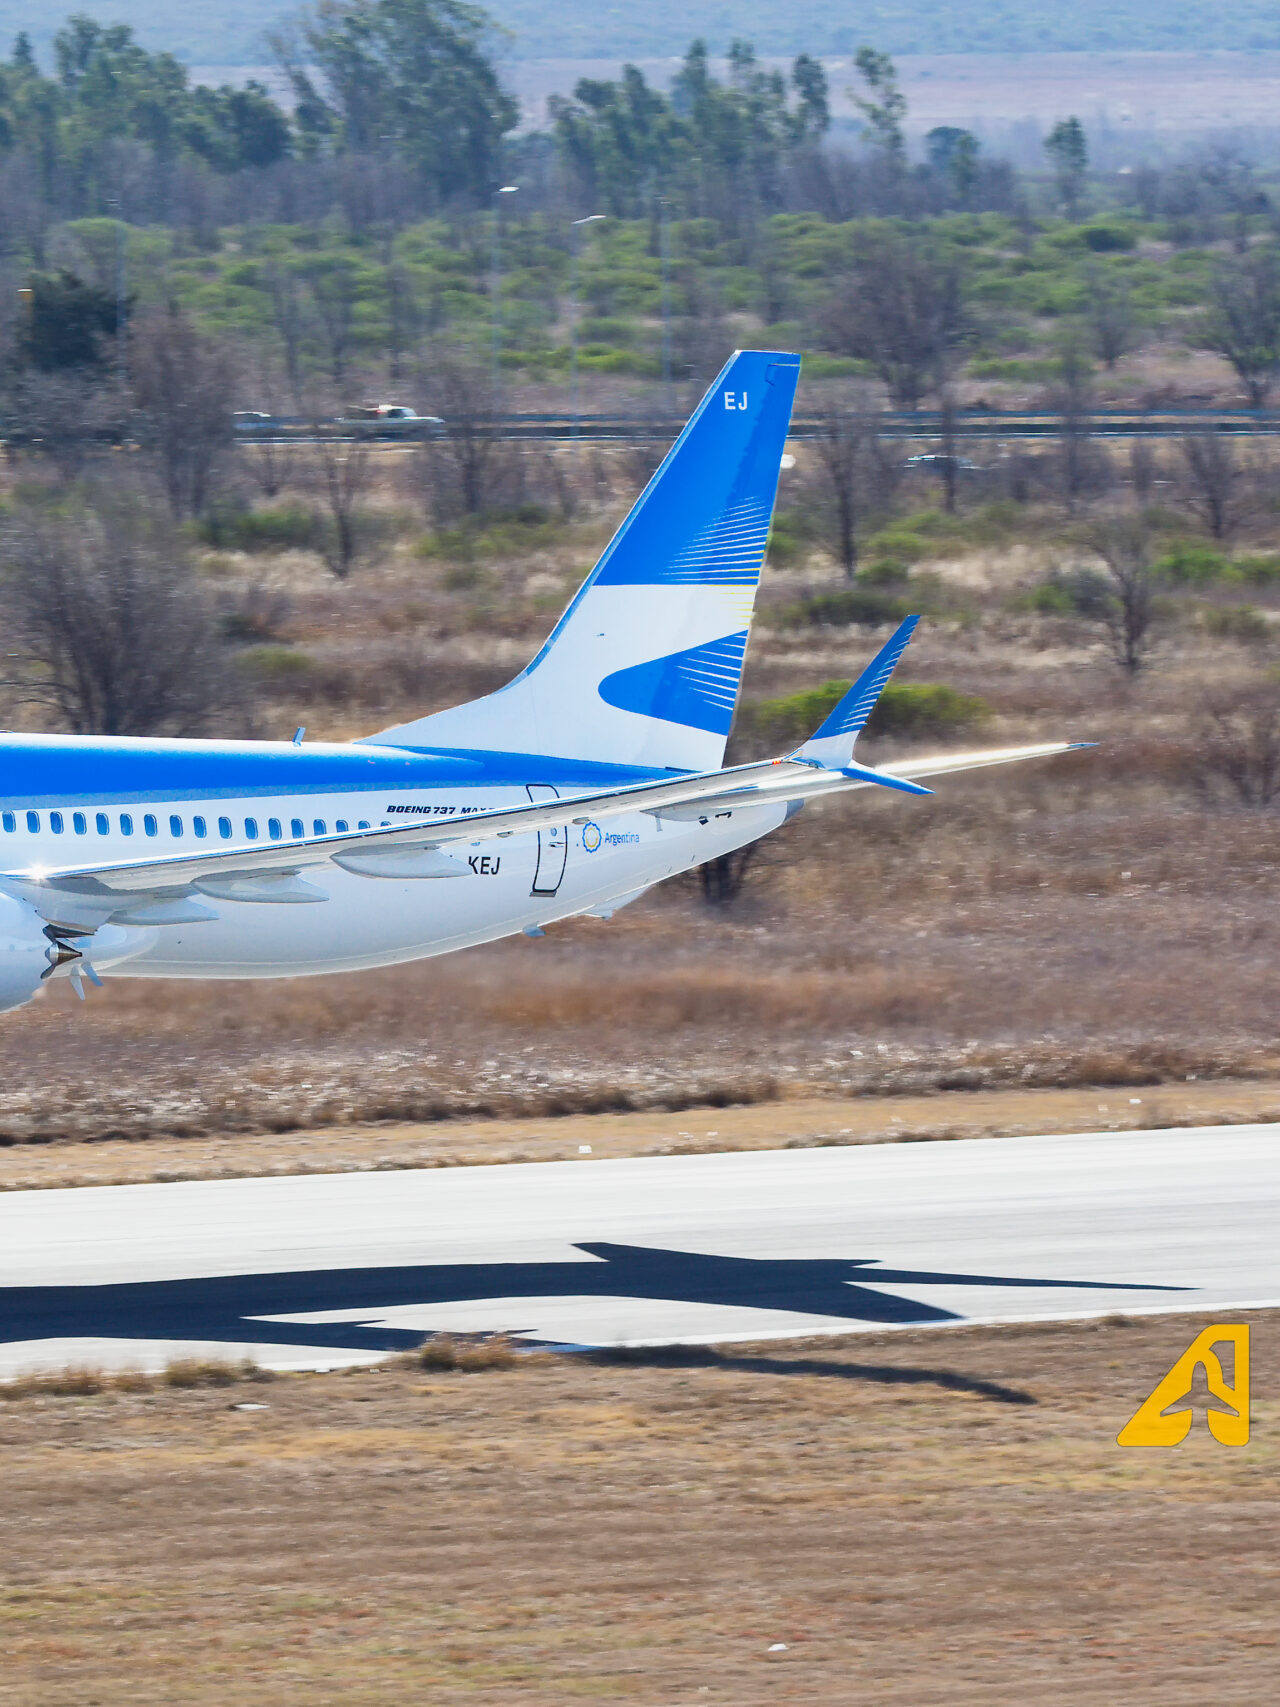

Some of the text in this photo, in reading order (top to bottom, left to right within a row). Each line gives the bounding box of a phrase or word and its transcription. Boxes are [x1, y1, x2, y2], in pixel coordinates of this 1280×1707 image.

[724, 391, 748, 411] EJ
[386, 805, 432, 814] BOEING
[433, 806, 456, 815] 737
[604, 831, 640, 846] Argentina
[468, 855, 501, 875] KEJ
